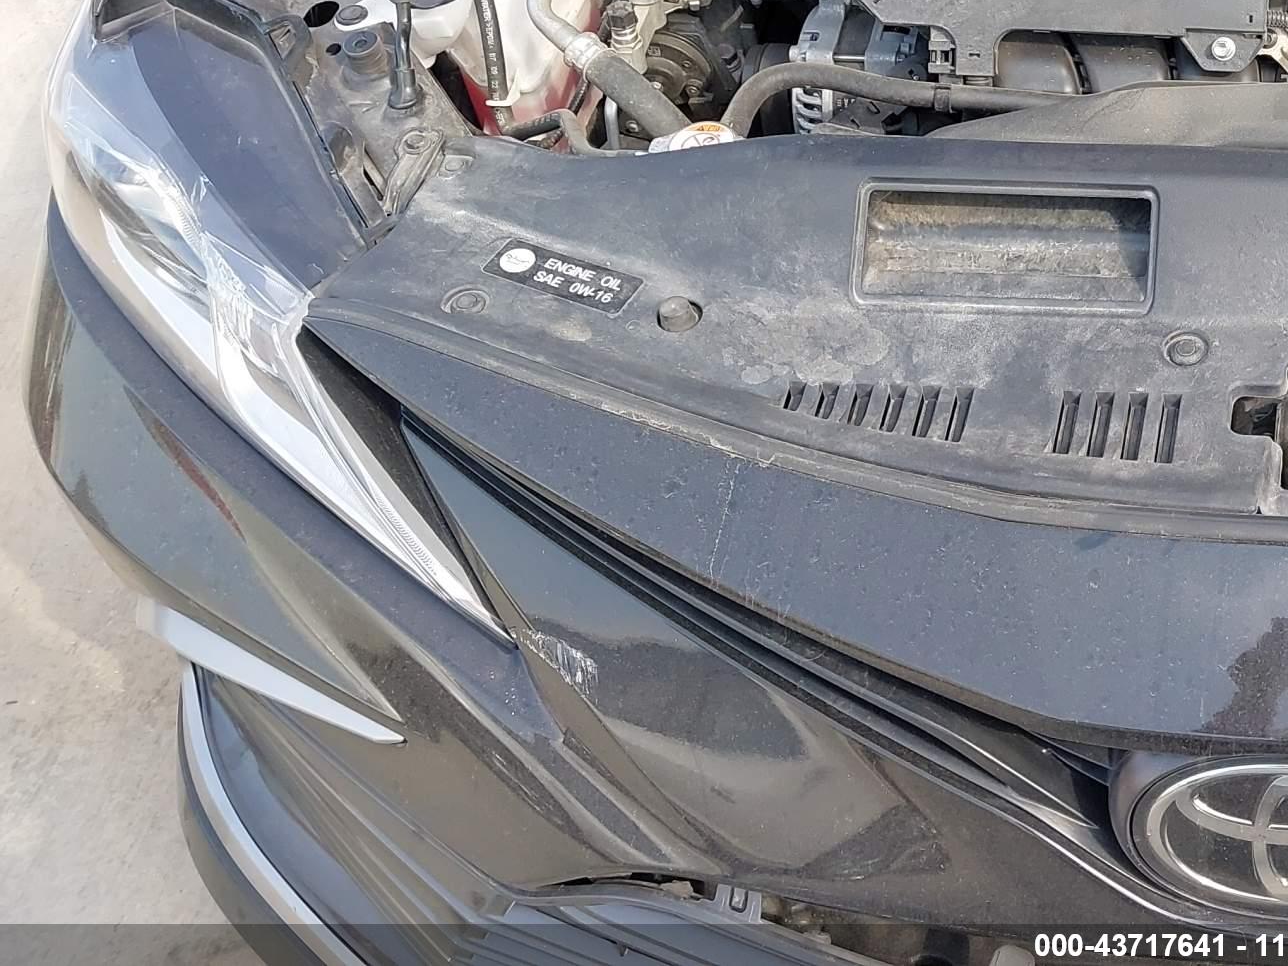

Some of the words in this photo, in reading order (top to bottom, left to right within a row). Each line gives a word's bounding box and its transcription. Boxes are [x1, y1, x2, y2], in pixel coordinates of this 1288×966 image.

[533, 270, 565, 288] SAE
[569, 282, 614, 303] 0W-16
[544, 257, 597, 282] ENGINE
[600, 276, 621, 291] OIL
